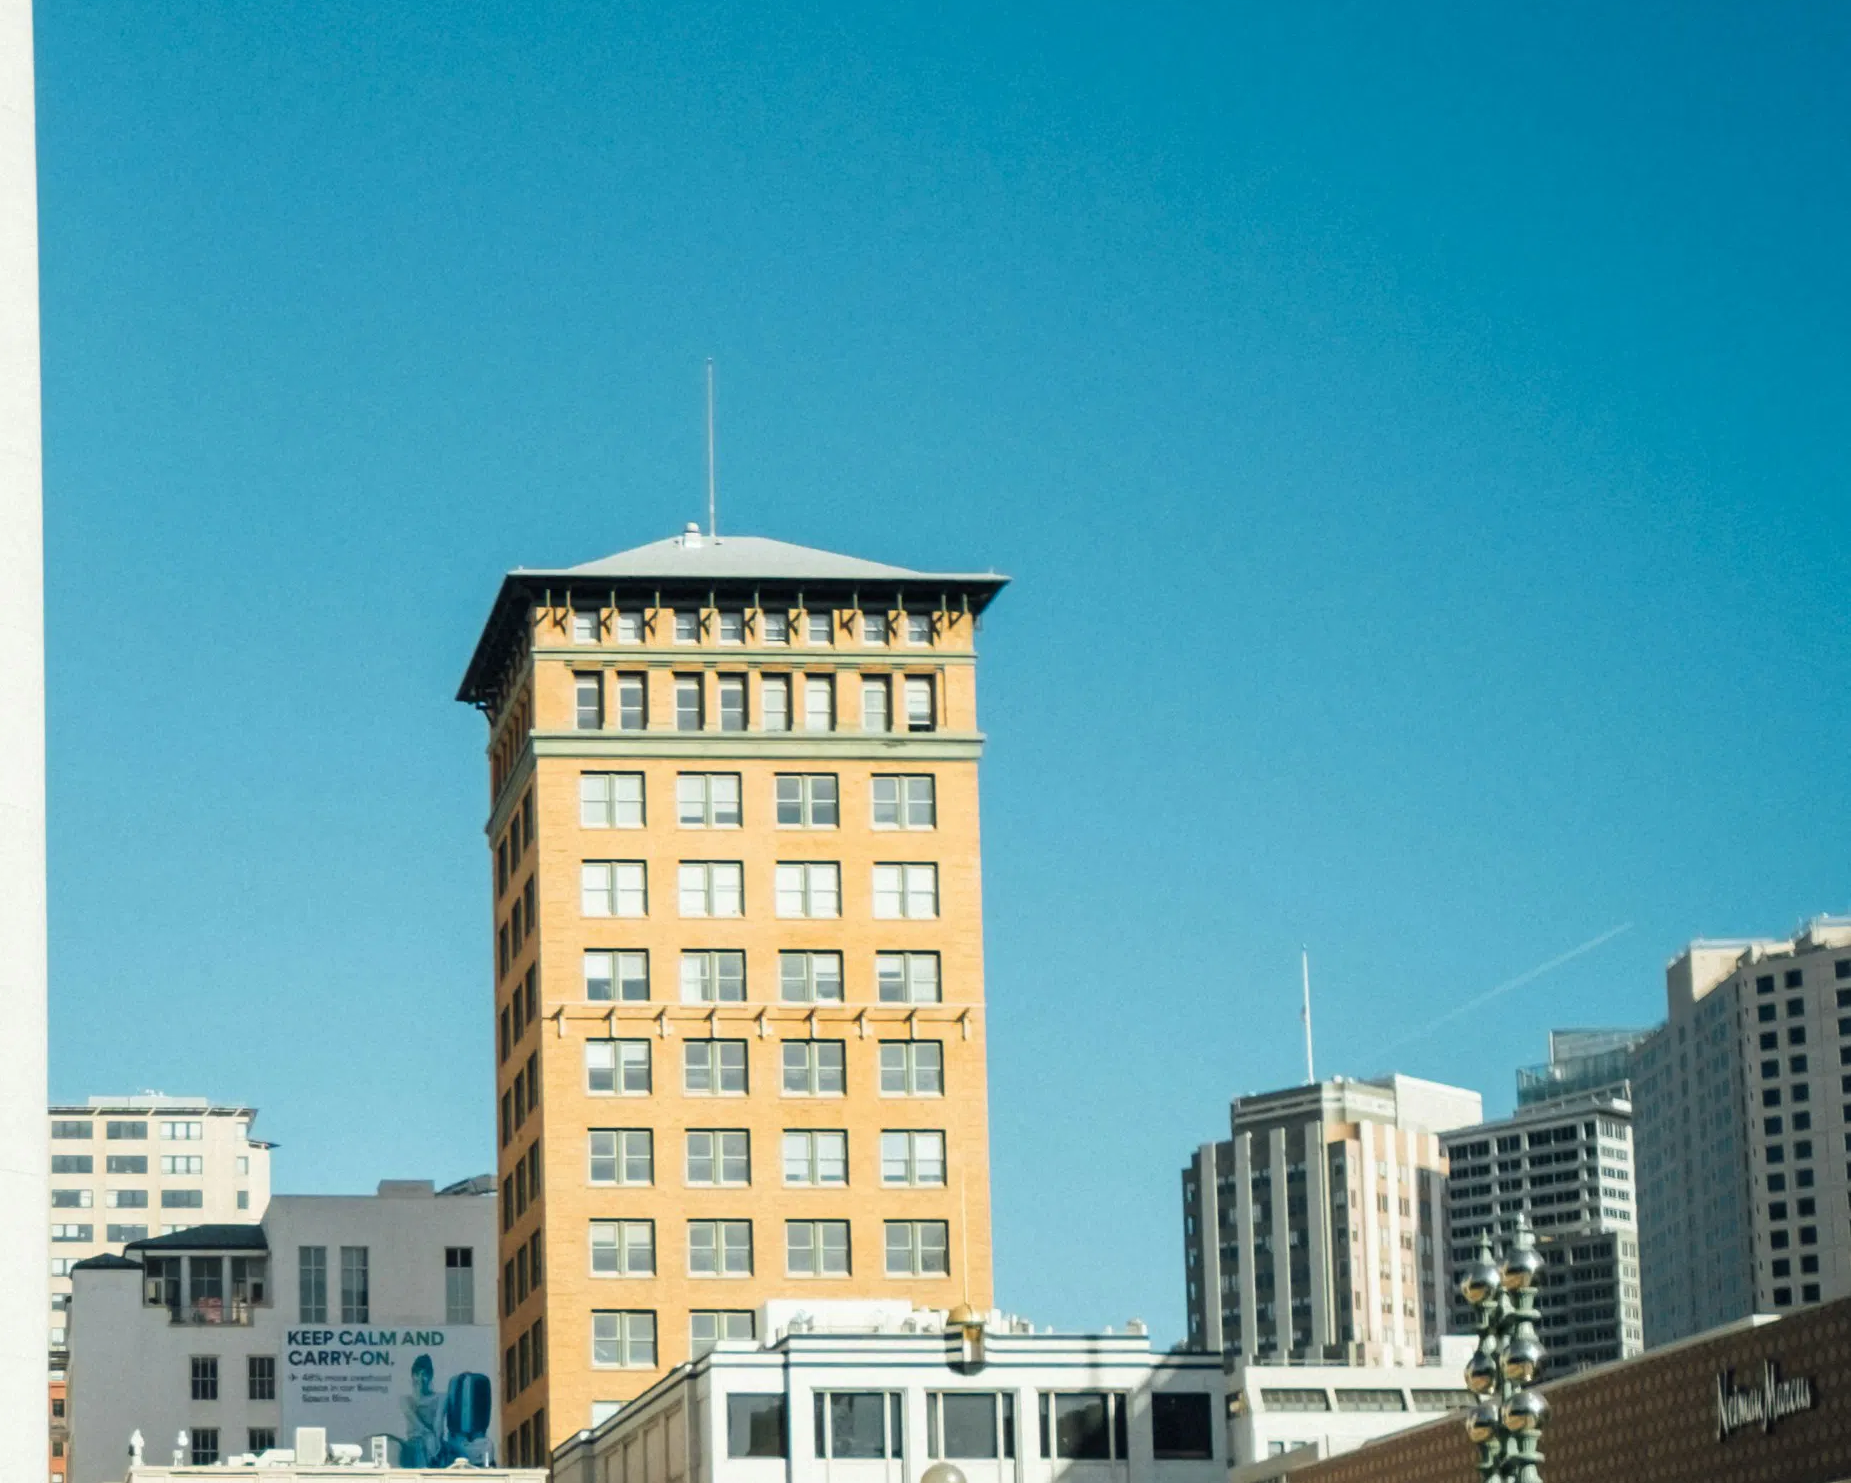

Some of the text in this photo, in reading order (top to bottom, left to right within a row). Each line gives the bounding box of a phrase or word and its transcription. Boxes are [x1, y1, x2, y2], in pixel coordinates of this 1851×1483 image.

[288, 1331, 445, 1346] KEEP CALM AND
[288, 1350, 395, 1366] CARRY-ON.
[1716, 1357, 1811, 1439] Neiman Marcus
